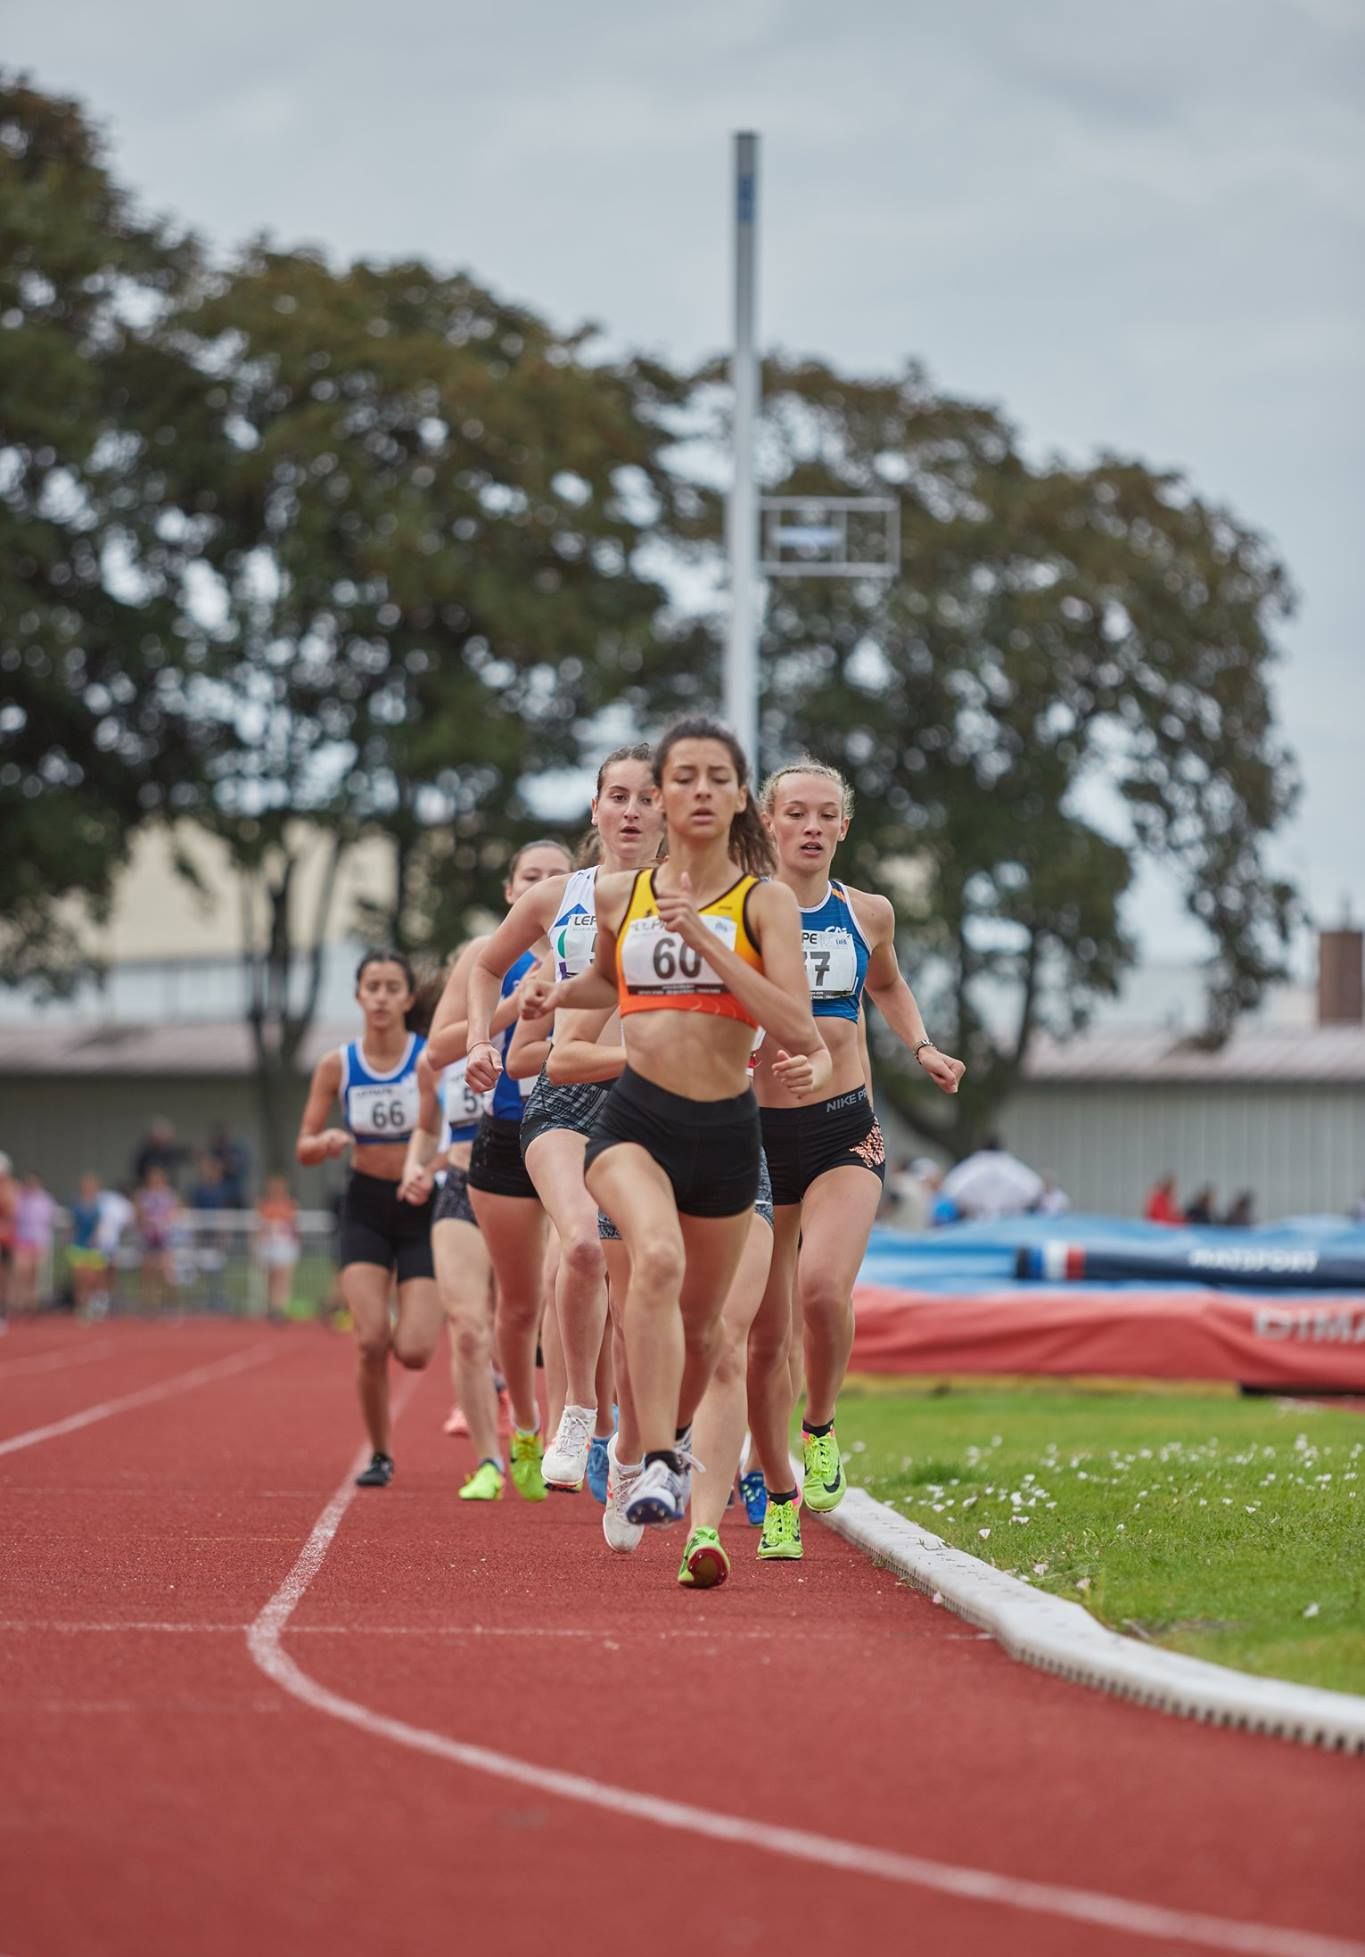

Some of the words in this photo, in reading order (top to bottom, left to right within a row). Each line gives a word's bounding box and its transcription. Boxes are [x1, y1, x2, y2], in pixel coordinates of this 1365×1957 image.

[653, 937, 702, 980] 60
[804, 951, 831, 987] 7
[371, 1100, 405, 1129] 66
[826, 1093, 857, 1113] NIKE
